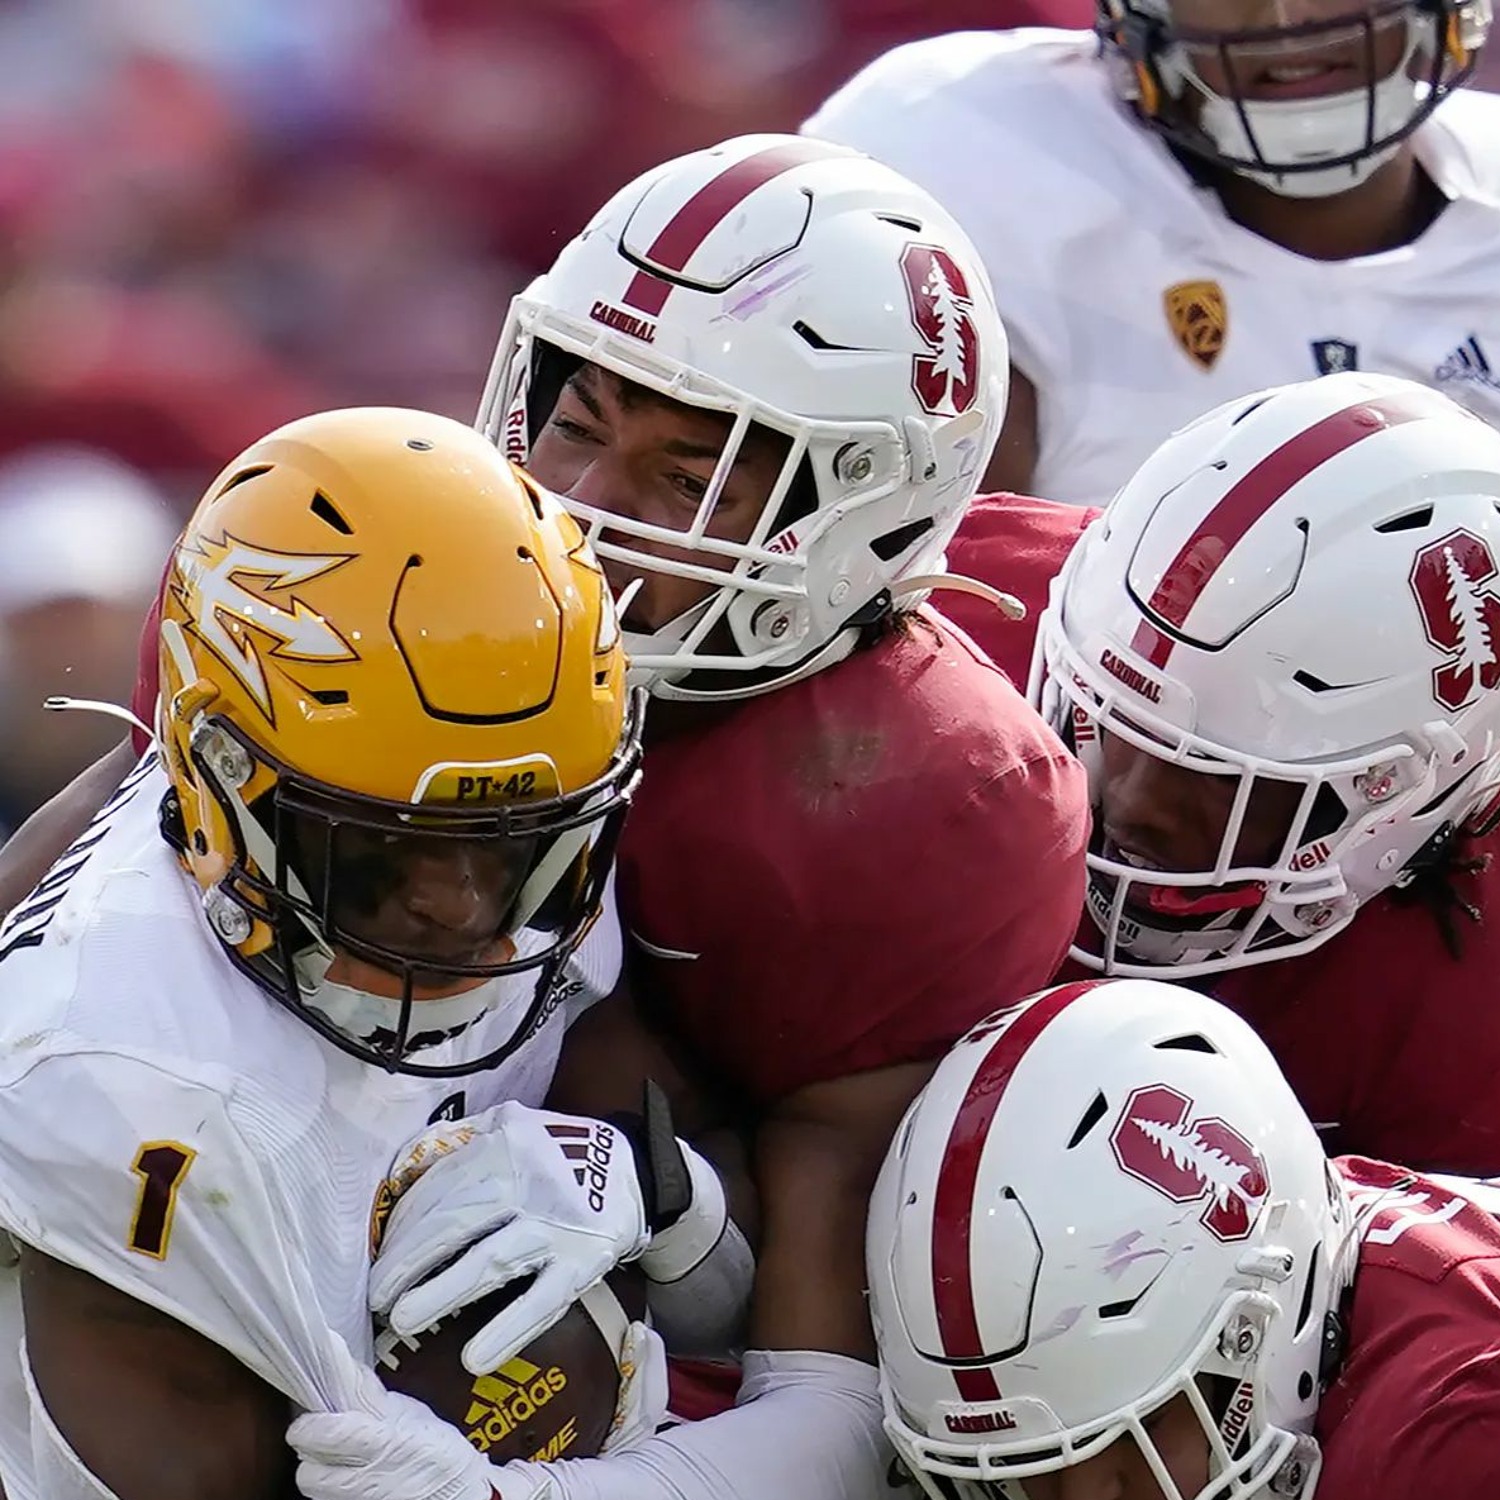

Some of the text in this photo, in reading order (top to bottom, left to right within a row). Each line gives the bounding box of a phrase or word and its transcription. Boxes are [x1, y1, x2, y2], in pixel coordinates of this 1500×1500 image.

[589, 301, 656, 344] CARDINAL
[1099, 649, 1161, 704] CARDINAL
[127, 1139, 198, 1261] 1
[588, 1125, 615, 1212] adidas
[466, 1366, 567, 1452] adidas
[944, 1410, 1017, 1433] CARDINAL
